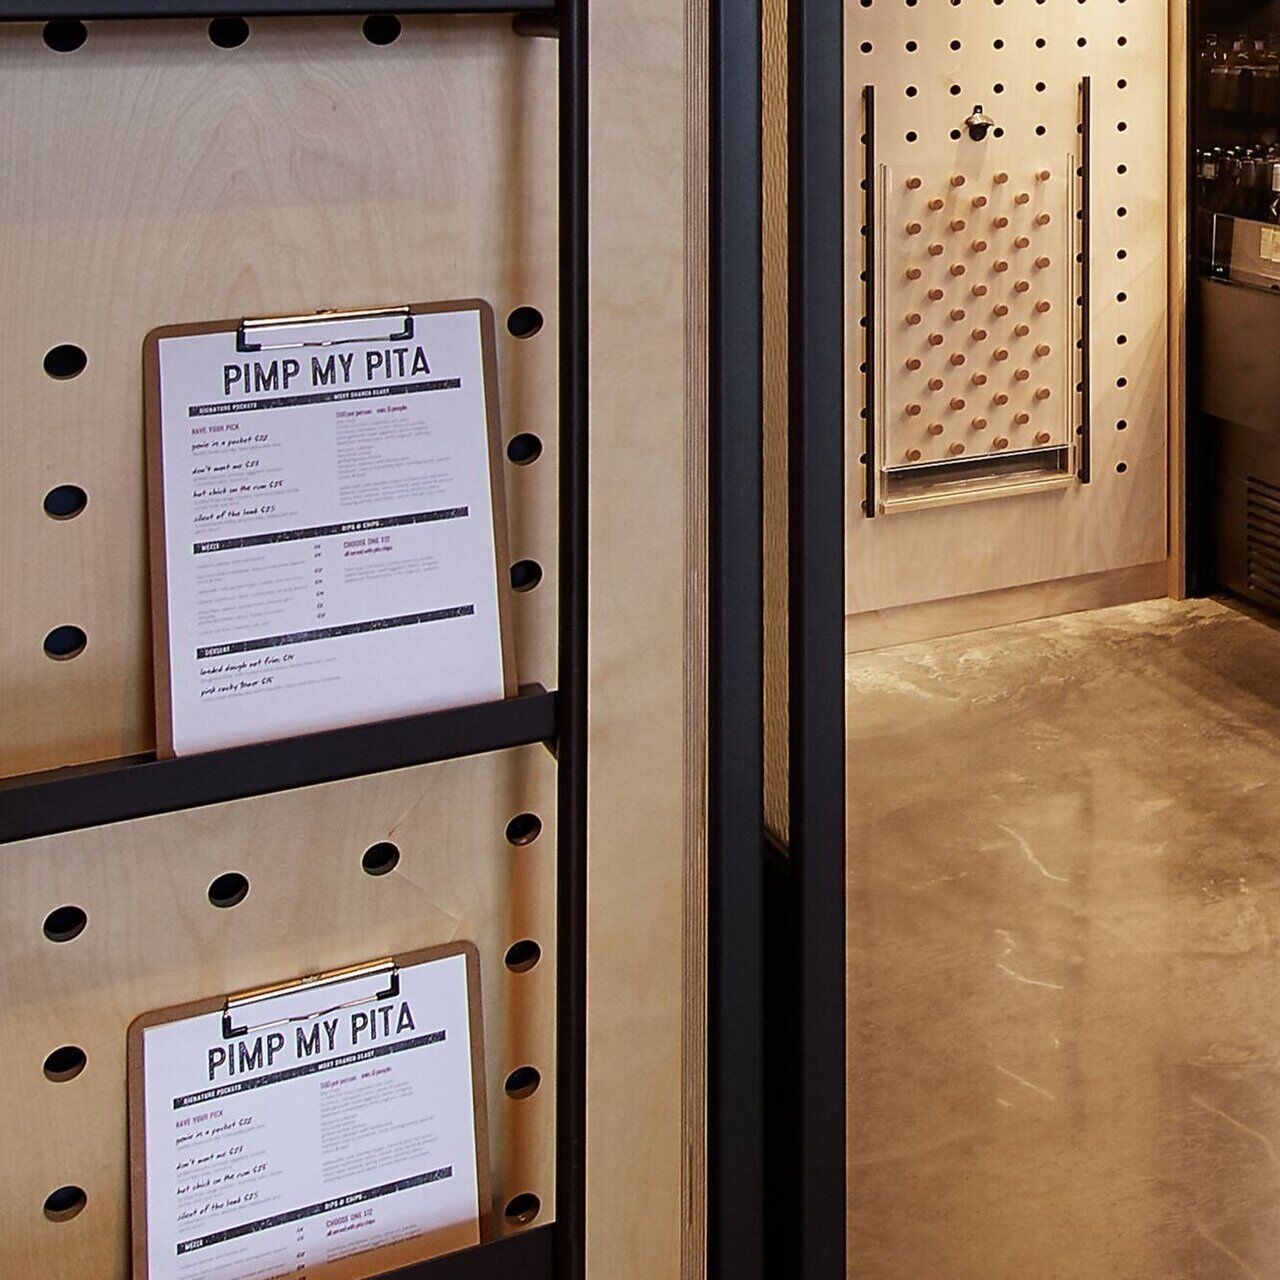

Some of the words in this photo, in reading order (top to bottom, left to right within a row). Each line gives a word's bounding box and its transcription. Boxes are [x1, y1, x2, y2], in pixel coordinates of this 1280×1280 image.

[223, 357, 301, 395] PIMP
[311, 353, 354, 388] MY
[366, 345, 430, 379] PITA
[208, 1031, 285, 1081] PIMP
[296, 1018, 338, 1058] MY
[351, 1001, 416, 1045] PITA
